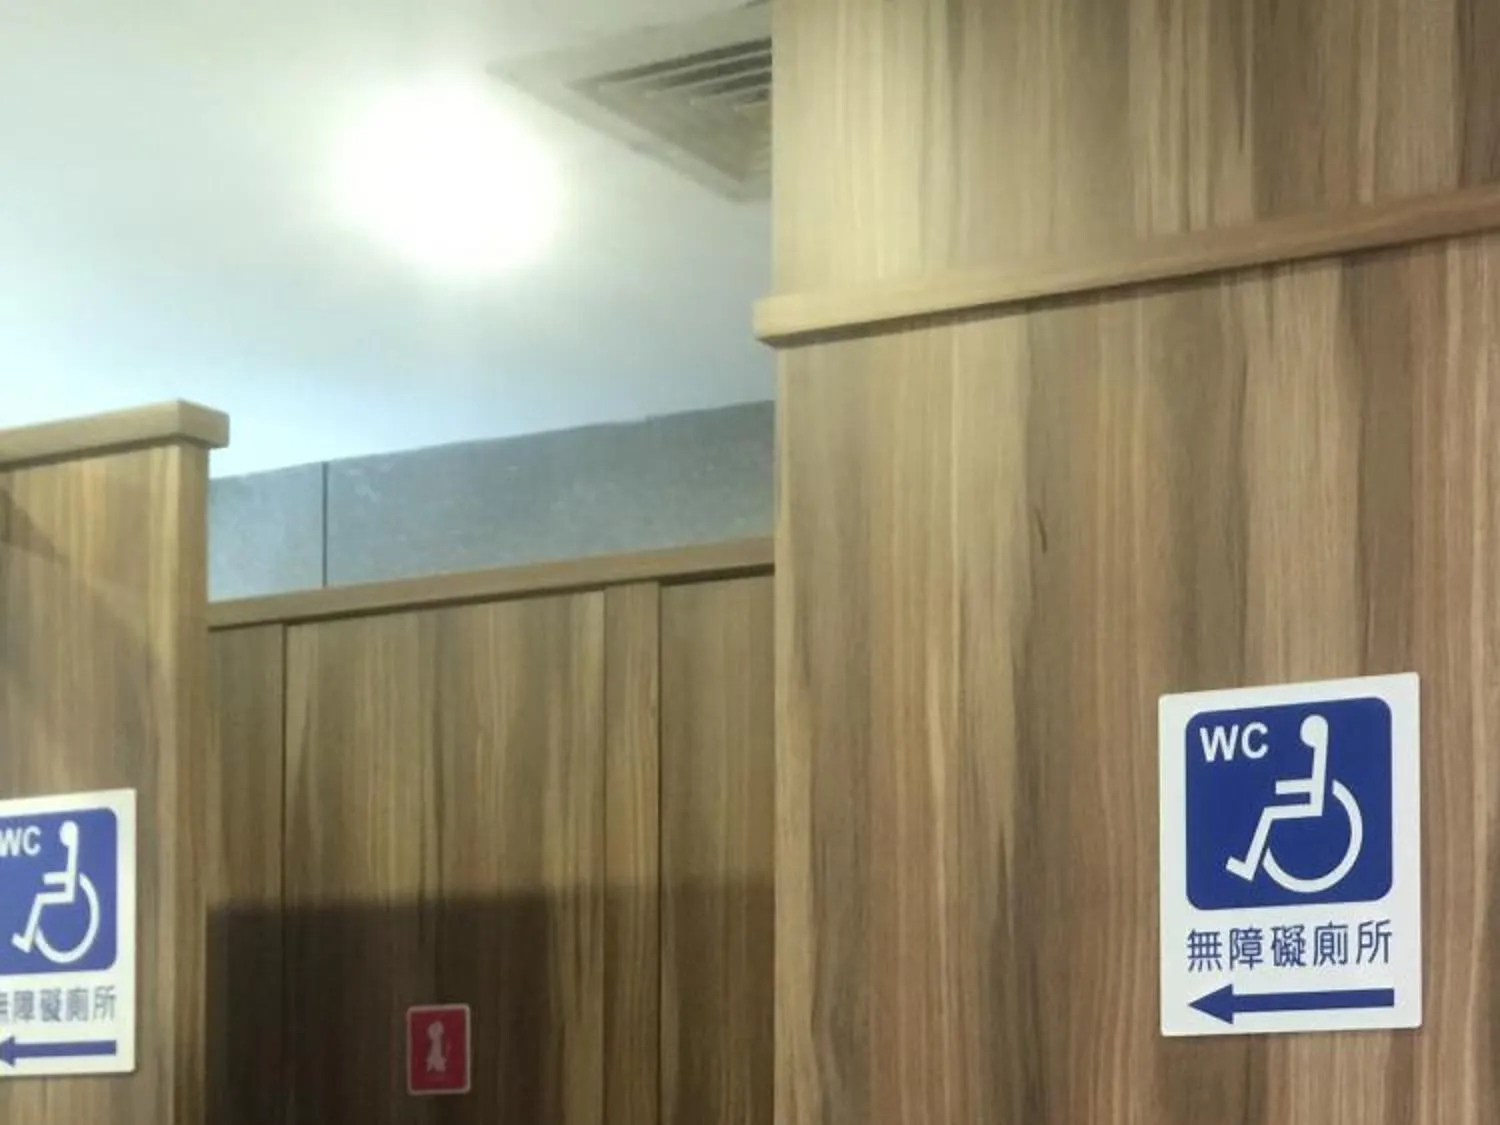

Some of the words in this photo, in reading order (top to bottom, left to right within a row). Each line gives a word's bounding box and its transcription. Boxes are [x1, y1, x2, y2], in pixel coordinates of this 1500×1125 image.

[1199, 721, 1269, 762] WC
[0, 826, 41, 857] WC
[1187, 919, 1393, 972] 無障礙廁所
